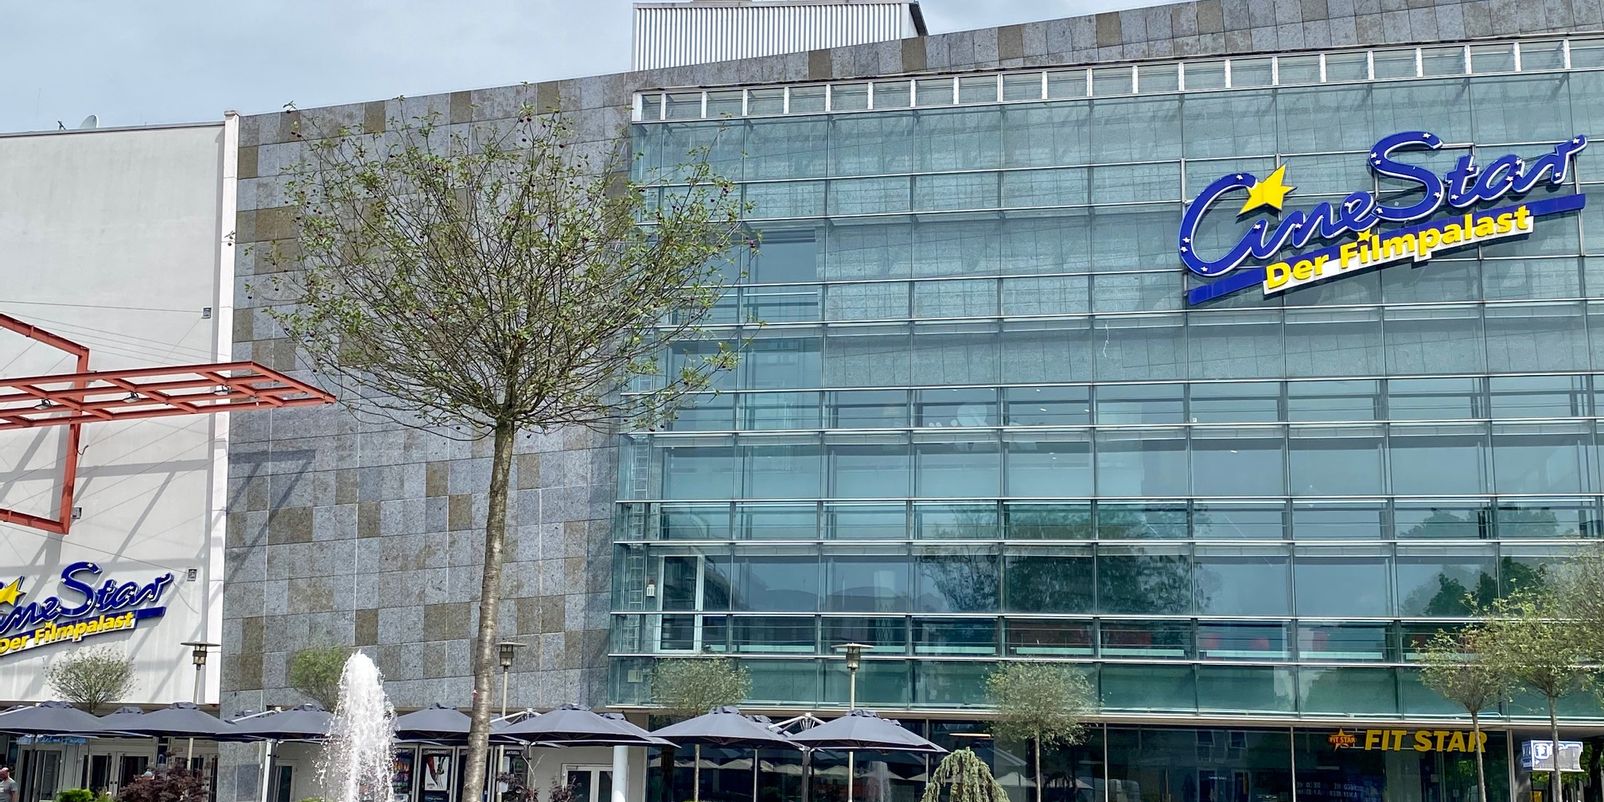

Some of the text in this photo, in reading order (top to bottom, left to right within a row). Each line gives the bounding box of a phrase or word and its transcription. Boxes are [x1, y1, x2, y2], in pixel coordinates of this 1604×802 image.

[1178, 131, 1588, 277] CineStar
[1265, 205, 1530, 289] Der Filmpalast
[0, 561, 174, 634] neStar
[34, 612, 134, 645] Filmpalast
[1364, 729, 1488, 753] FIT STAR
